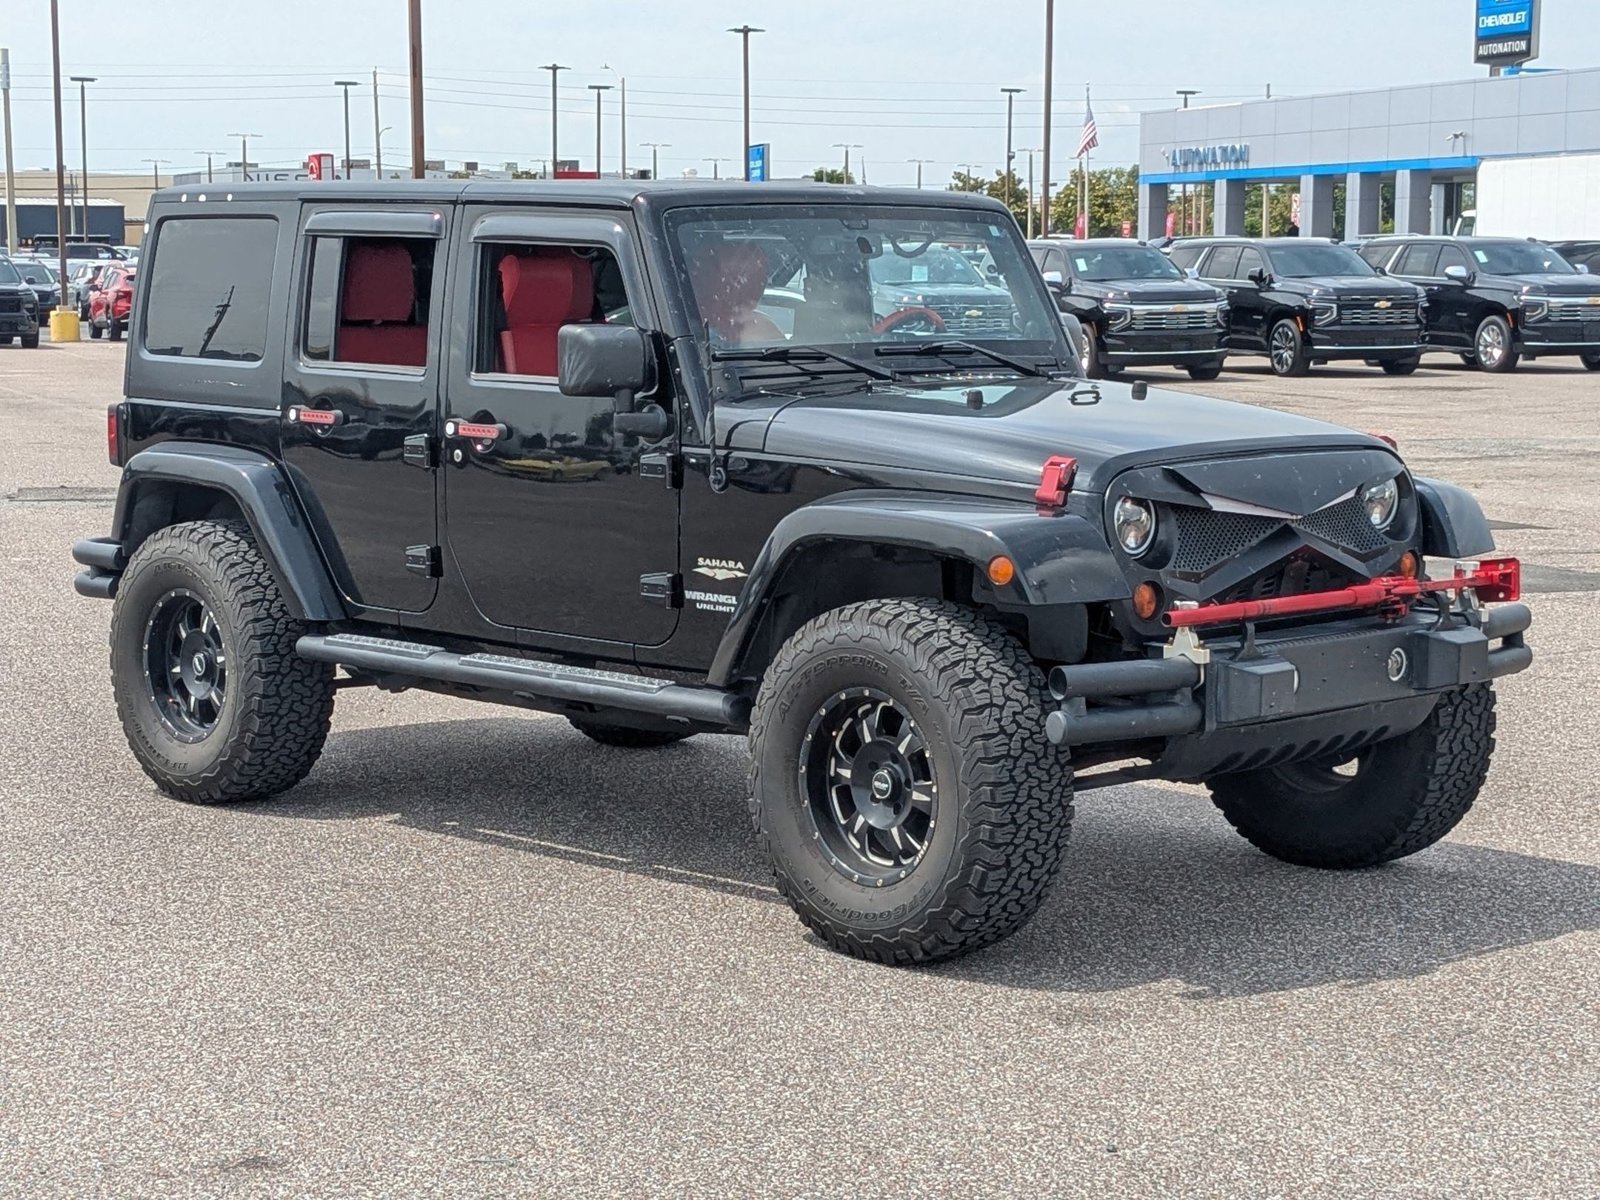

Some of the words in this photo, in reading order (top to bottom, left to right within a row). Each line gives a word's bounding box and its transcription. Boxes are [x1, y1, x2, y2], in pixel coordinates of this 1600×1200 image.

[1479, 11, 1527, 28] CHEVROLET
[1478, 40, 1527, 56] AUTONATION
[1171, 144, 1250, 167] AUTONATION
[697, 557, 744, 570] SAHARA
[685, 590, 738, 604] WRANGL
[696, 603, 736, 613] UNLIMIT
